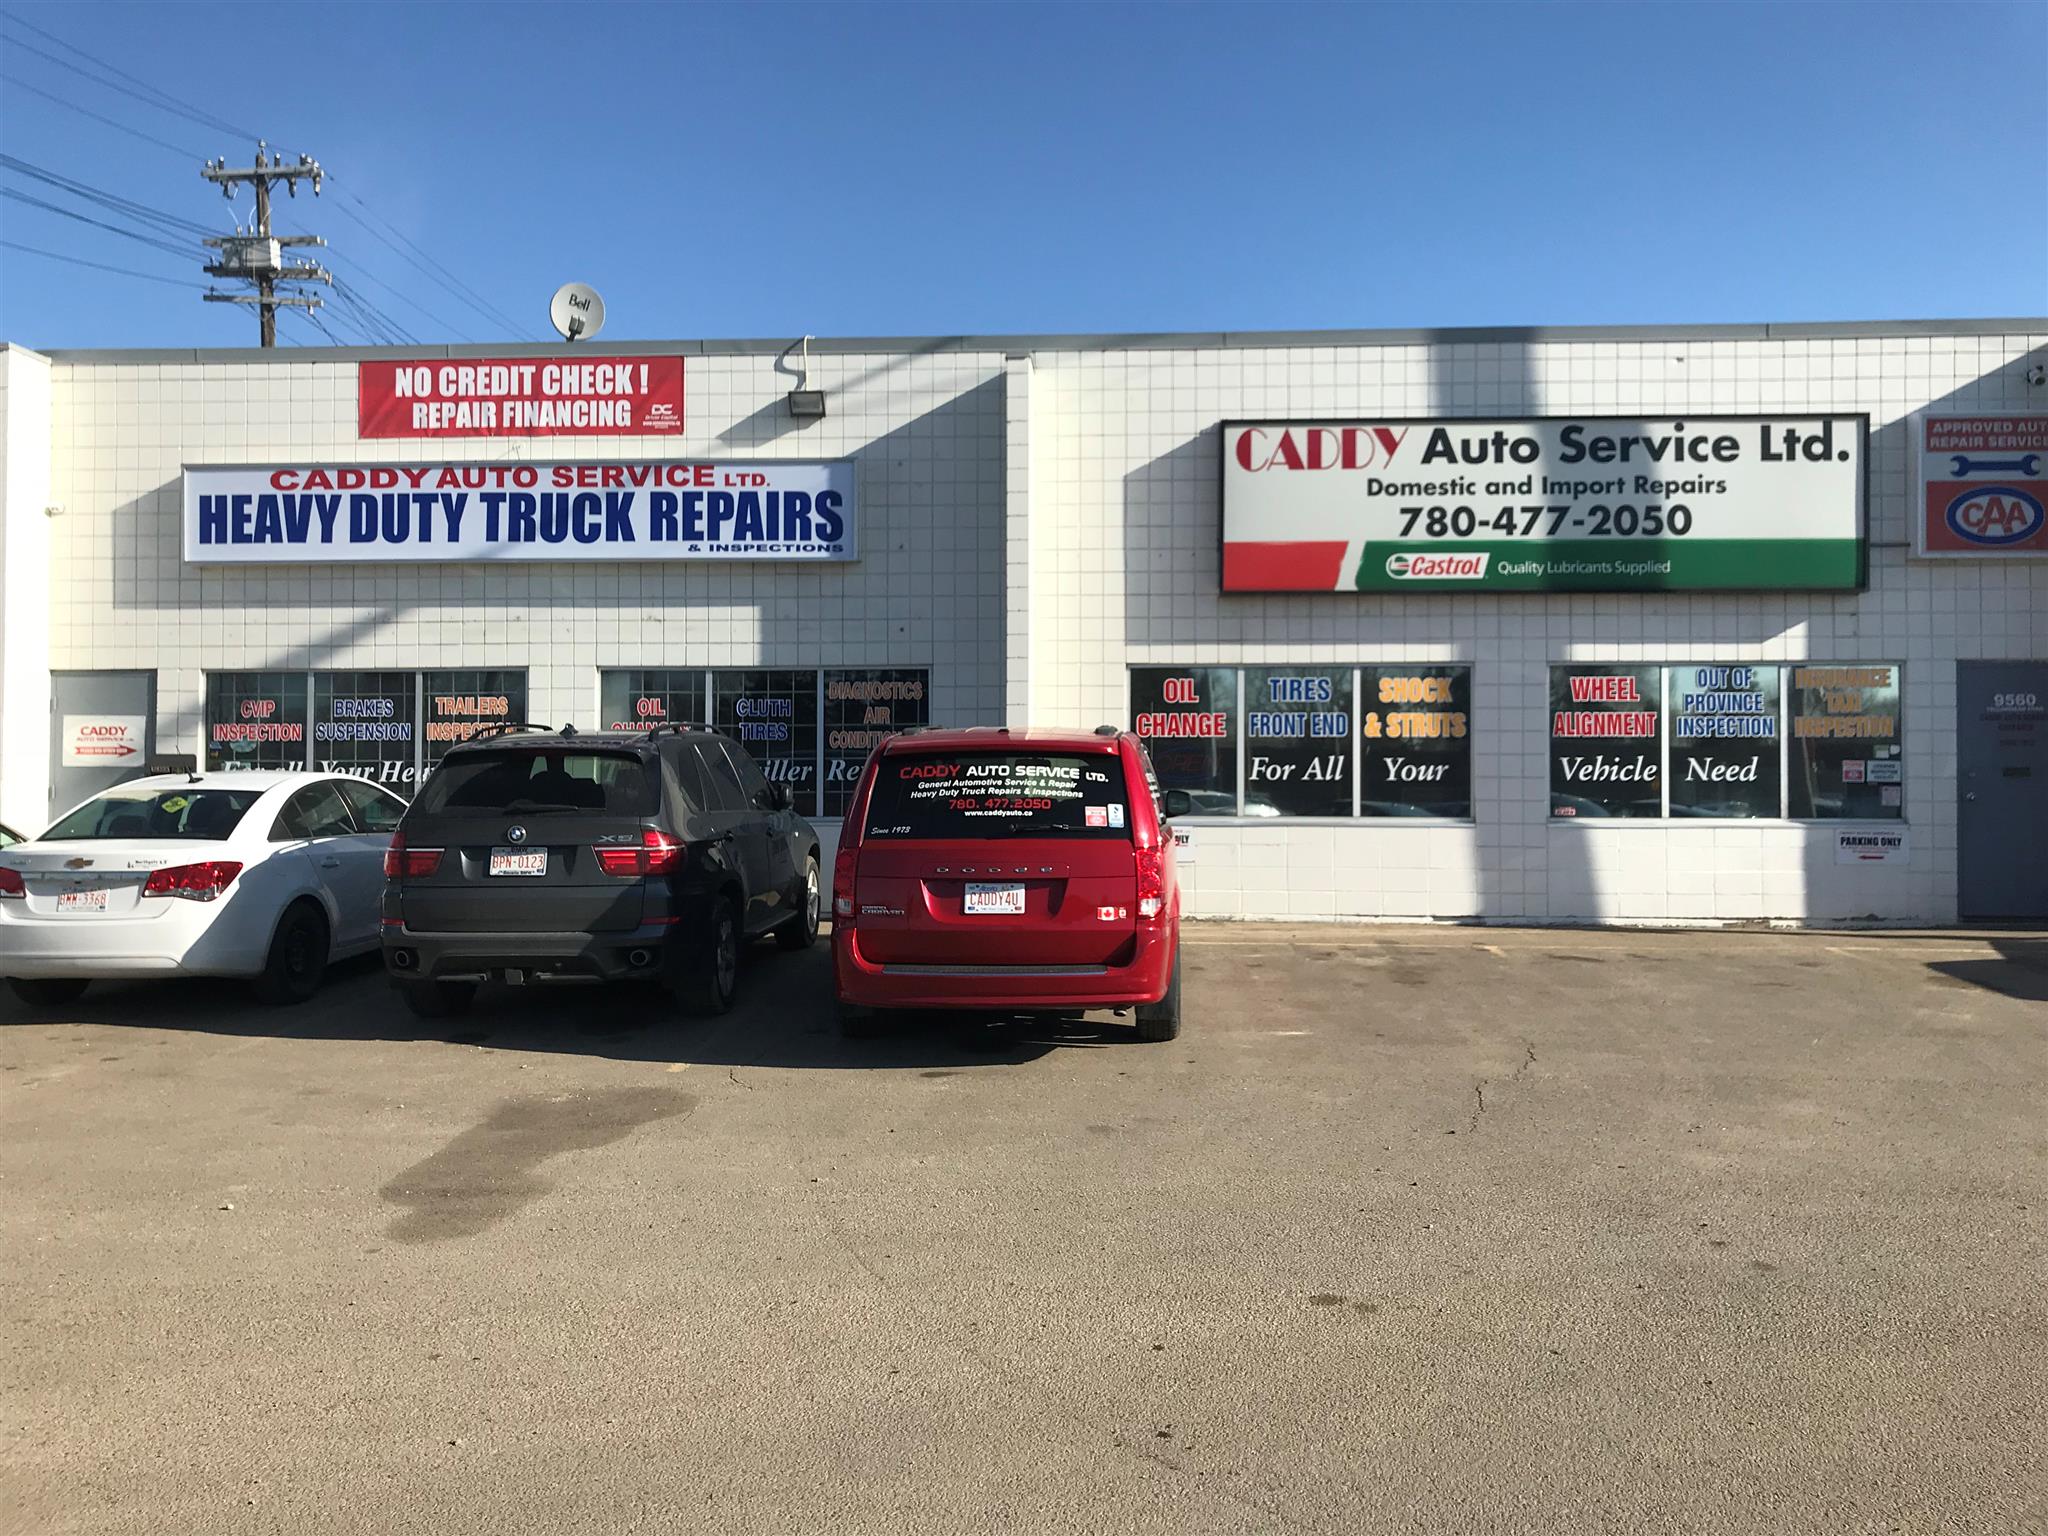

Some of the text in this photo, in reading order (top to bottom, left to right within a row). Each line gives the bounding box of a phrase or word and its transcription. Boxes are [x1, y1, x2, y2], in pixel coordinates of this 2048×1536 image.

[569, 293, 591, 312] Bell
[395, 368, 430, 398] NO
[439, 365, 536, 397] CREDIT
[543, 364, 632, 395] CHECK
[412, 400, 631, 430] REPAIR FINANCING
[1933, 420, 2048, 433] APPROVED AUT
[1236, 422, 1850, 472] CADDY Auto Service Ltd.
[1930, 436, 1983, 448] REPAIR
[270, 465, 770, 492] CADDY AUTO SERVICE LTD.
[1367, 475, 1726, 500] Domestic and Import Repairs
[199, 490, 844, 544] HEAVY DUTY TRUCK REPAIRS
[1399, 505, 1692, 538] 780-477-2050
[1961, 497, 2028, 535] CAA
[688, 543, 844, 553] & INSPECTIONS
[1411, 556, 1481, 576] Castrol
[1498, 560, 1671, 576] Quality Lubricants Supplied
[1696, 668, 1753, 689] OUT OF
[828, 681, 923, 700] DIAGNOSTICS
[1163, 677, 1199, 703] OIL
[1268, 677, 1331, 703] TIRES
[1378, 677, 1453, 703] SHOCK
[1569, 676, 1641, 702] WHEEL
[241, 700, 275, 718] CVIP
[333, 699, 394, 718] BRAKES
[435, 696, 508, 715] TRAILERS
[637, 698, 666, 716] OIL
[736, 699, 792, 718] CLUTH
[1684, 692, 1764, 713] PROVINCE
[863, 706, 891, 725] AIR
[1136, 712, 1227, 738] CHANGE
[1249, 712, 1348, 737] FRONT END
[1364, 712, 1466, 738] & STRUTS
[1552, 712, 1657, 738] ALIGNMENT
[80, 726, 128, 736] CADDY
[213, 723, 302, 741] INSPECTION
[316, 722, 411, 741] SUSPENSION
[427, 722, 516, 741] INSPEC
[739, 722, 788, 741] TIRES
[1676, 716, 1775, 738] INSPECTION
[1794, 715, 1893, 738] INSPECTION
[760, 759, 813, 782] iller
[900, 764, 1109, 783] CADDY AUTO SERVICE LTD.
[1249, 755, 1449, 782] For All Your
[1559, 755, 1759, 782] Vehicle Need
[910, 787, 1084, 799] Heavy Duty Truck Repairs & Inspections
[918, 778, 1077, 789] General Automotive Service & Repair
[984, 798, 1051, 809] 477.2050
[964, 809, 1033, 818] www.caddyauto.ca
[1840, 836, 1902, 847] PARKING ONLY
[493, 855, 544, 869] BPN-0123
[969, 891, 1018, 906] CADDY4U
